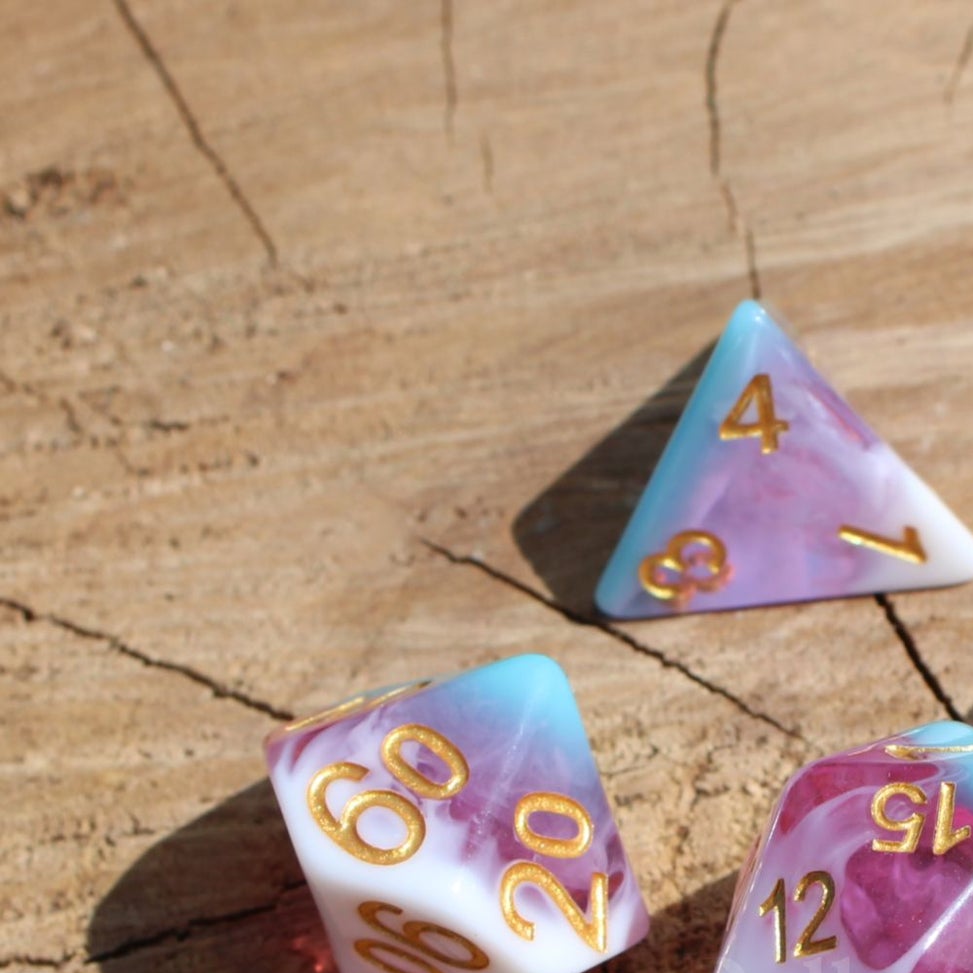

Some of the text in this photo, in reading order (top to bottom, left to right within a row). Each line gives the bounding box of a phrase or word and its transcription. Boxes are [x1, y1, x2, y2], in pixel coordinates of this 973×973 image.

[720, 373, 789, 454] 4
[838, 524, 928, 565] 1
[306, 723, 470, 866] 60
[870, 781, 972, 856] 15
[500, 791, 609, 954] 20
[759, 870, 838, 964] 12
